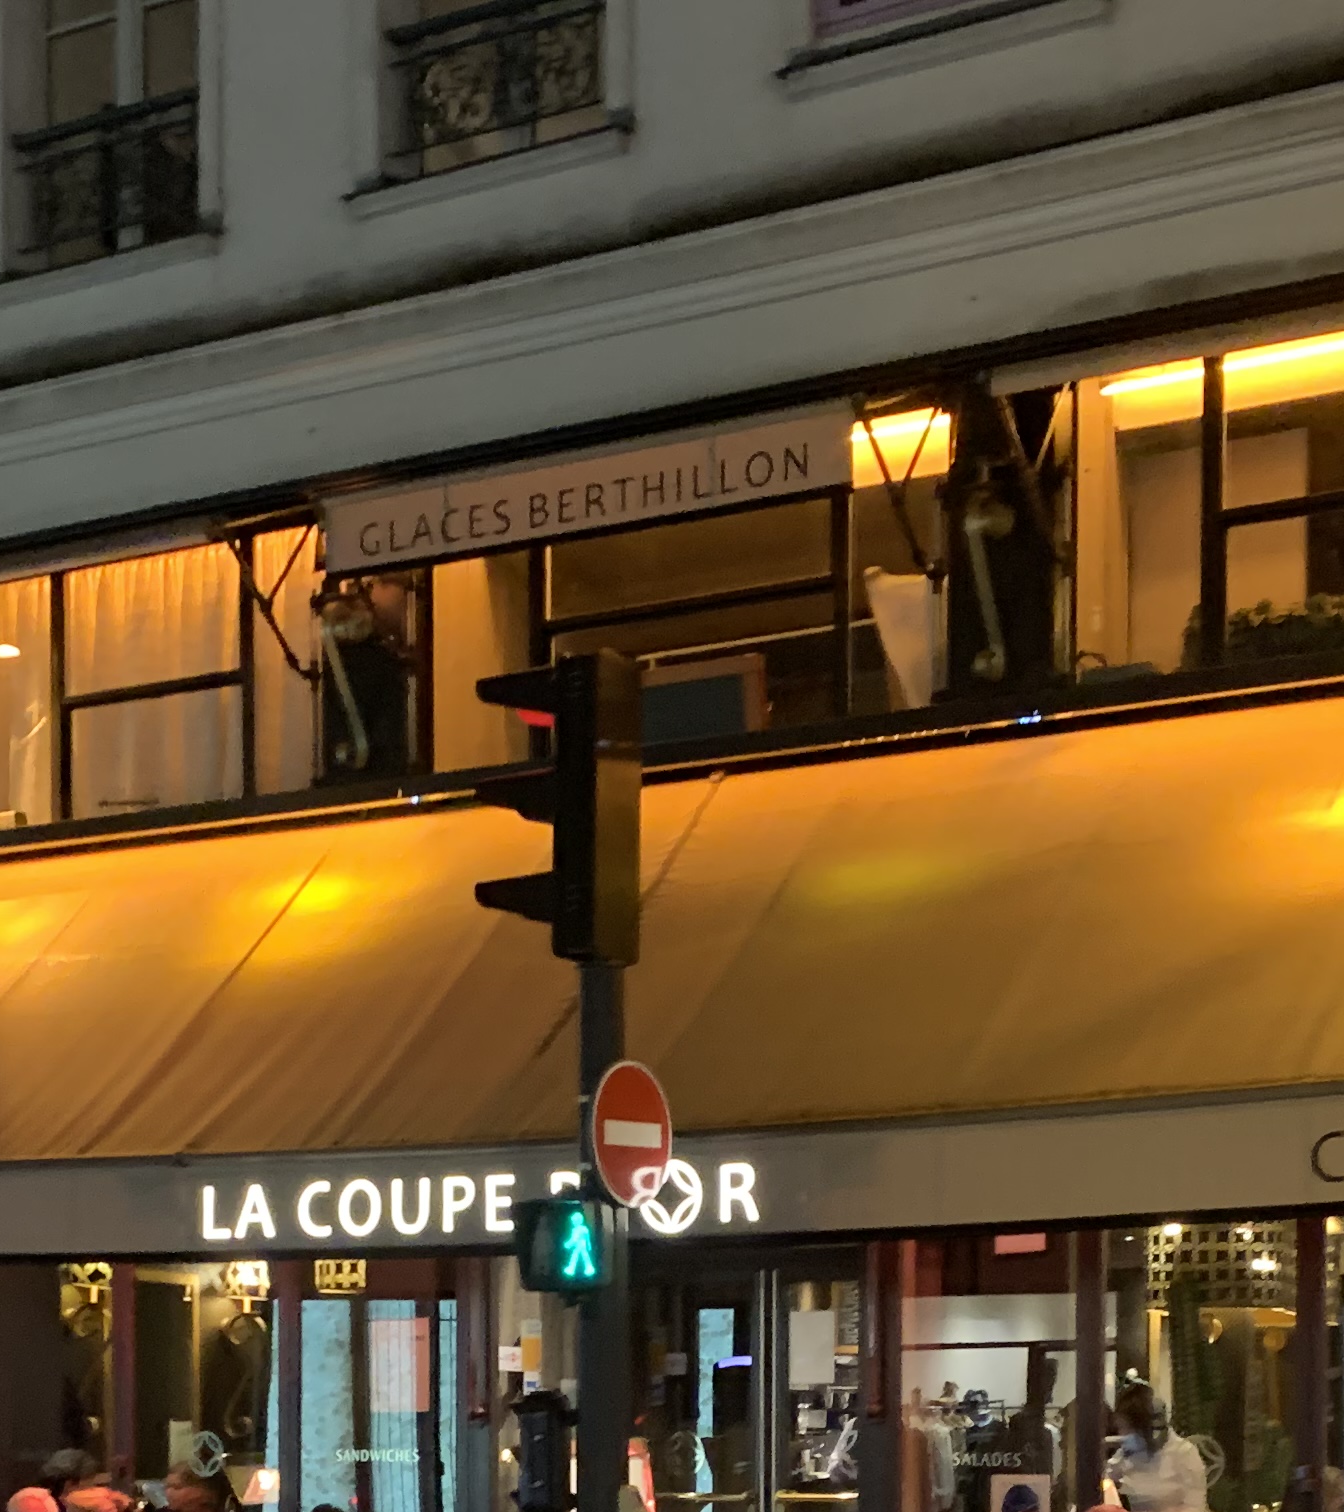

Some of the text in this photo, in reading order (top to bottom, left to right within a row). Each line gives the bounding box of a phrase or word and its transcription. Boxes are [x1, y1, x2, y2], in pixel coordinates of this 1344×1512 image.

[359, 442, 811, 558] GLACES BERTHILLON
[201, 1182, 277, 1241] LA
[296, 1172, 517, 1239] COUPE
[335, 1447, 420, 1463] SANDWICHES
[952, 1450, 1023, 1468] SALADES
